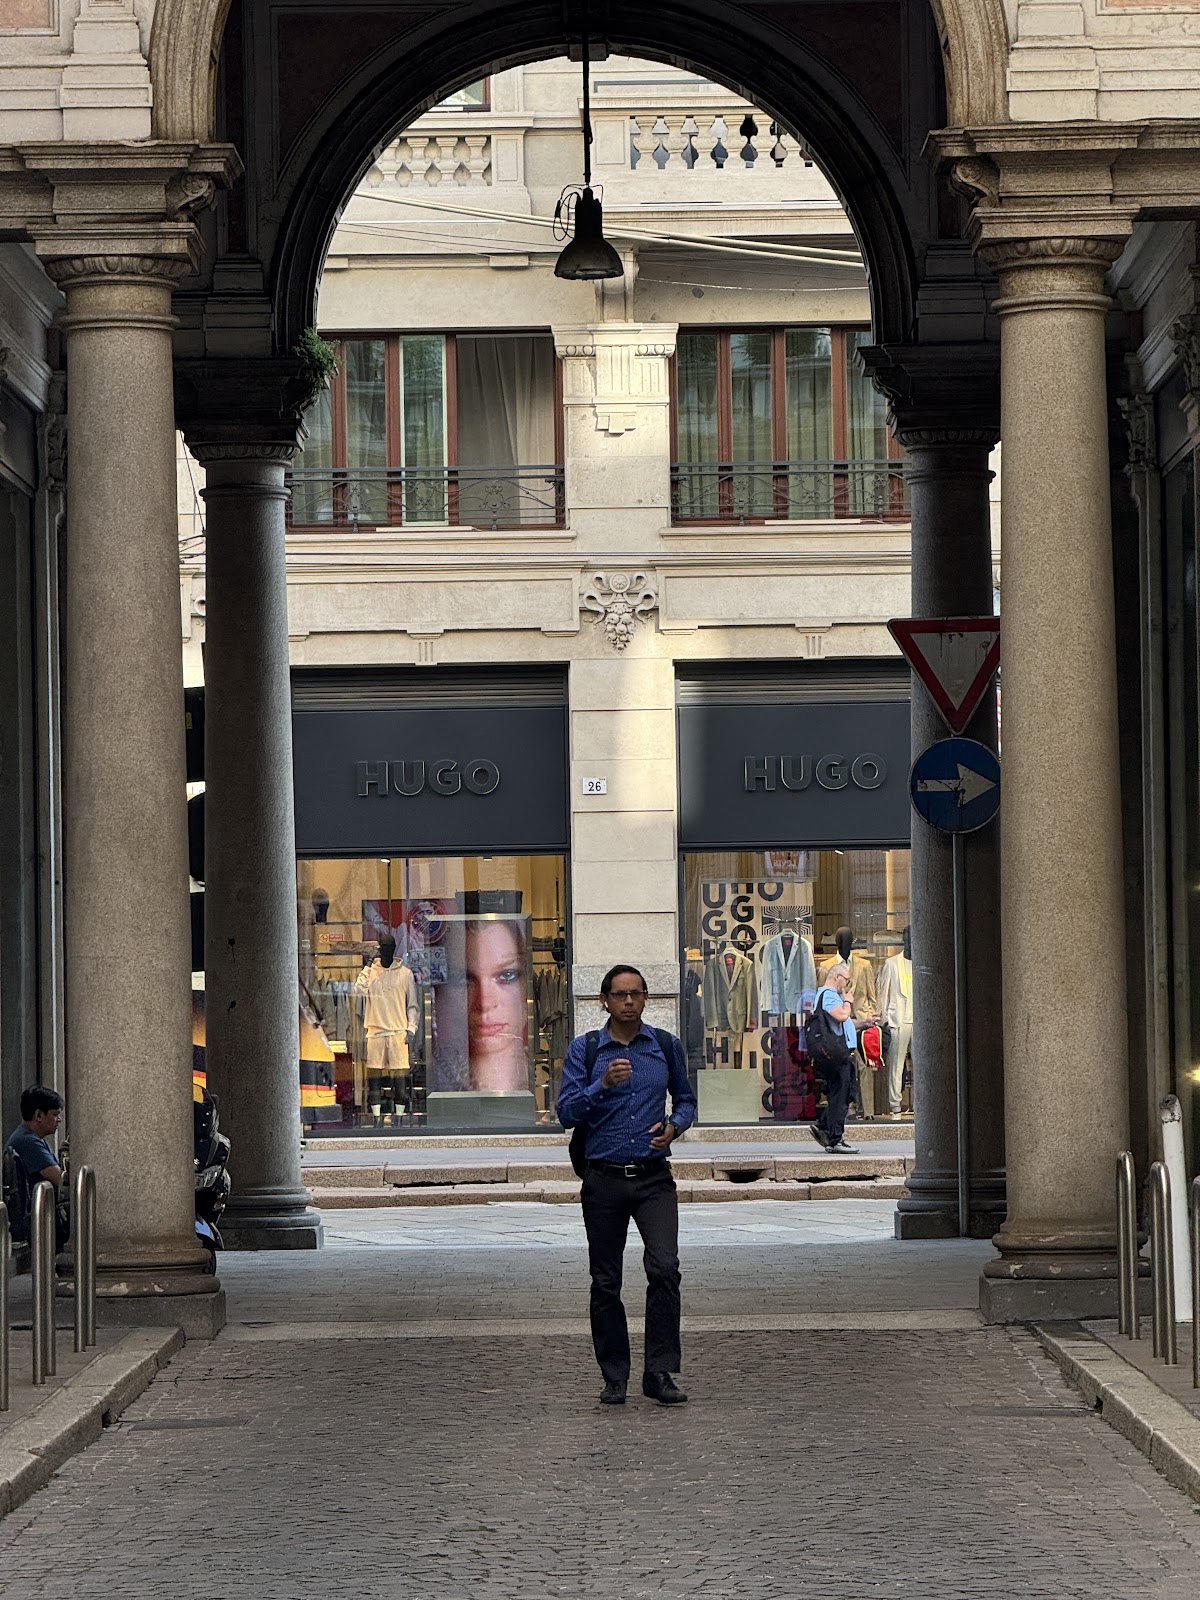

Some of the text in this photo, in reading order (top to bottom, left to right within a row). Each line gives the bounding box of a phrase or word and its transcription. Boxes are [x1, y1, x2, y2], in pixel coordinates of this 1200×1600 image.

[356, 759, 500, 796] HUGO
[588, 781, 602, 792] 26
[744, 753, 887, 790] HUGO
